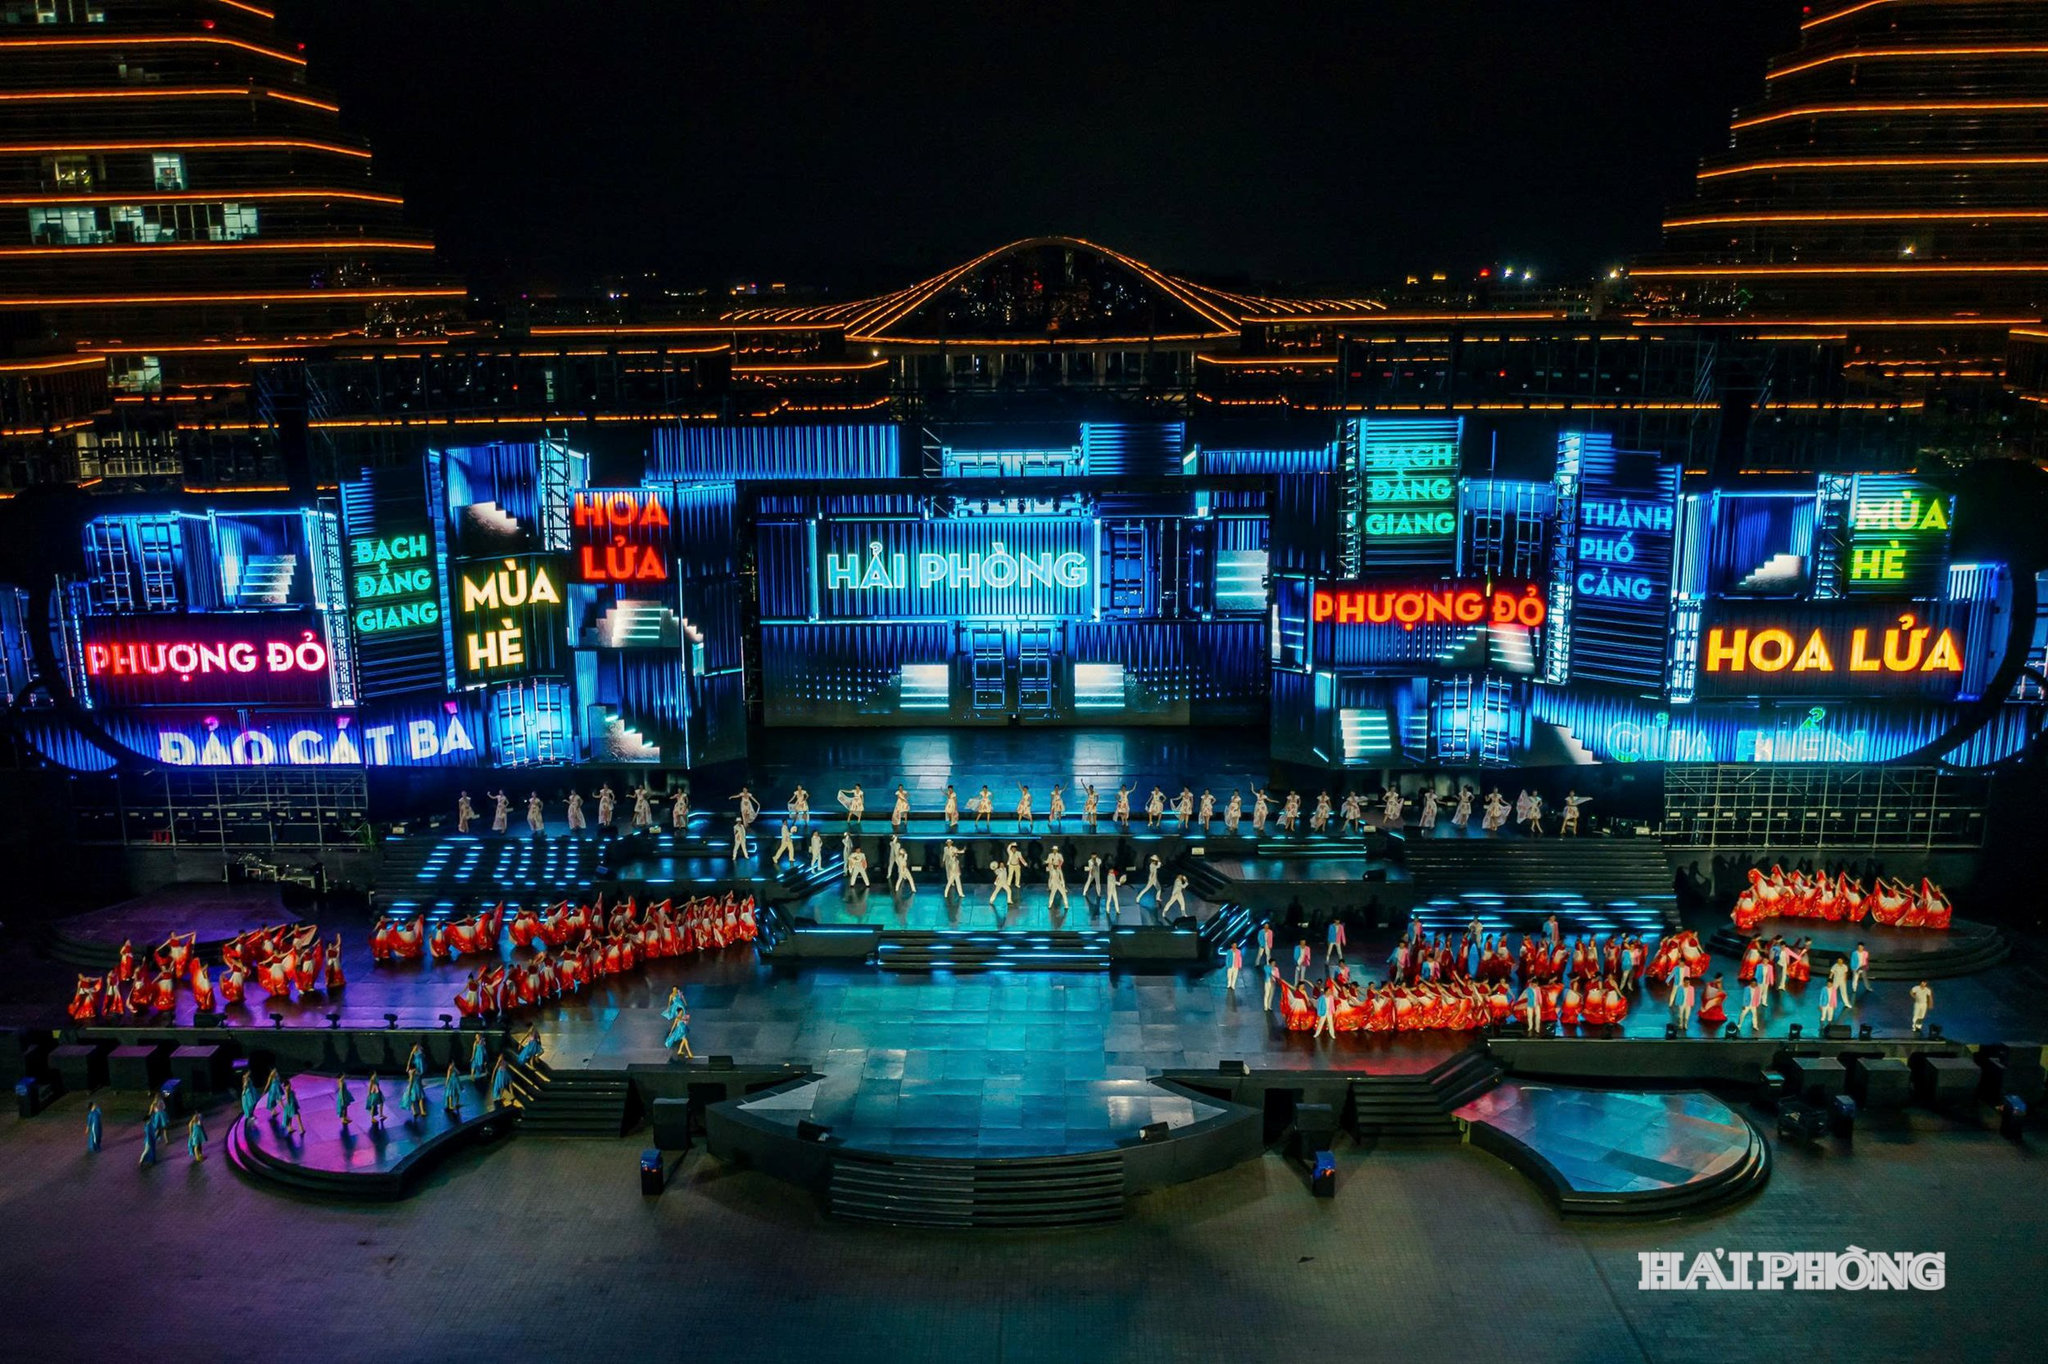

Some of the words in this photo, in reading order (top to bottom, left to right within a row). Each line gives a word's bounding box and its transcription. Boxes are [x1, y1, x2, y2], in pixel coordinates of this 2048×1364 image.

[575, 491, 669, 526] HOA
[1366, 512, 1456, 535] GIANG
[1581, 499, 1674, 530] THÀNH
[1856, 491, 1947, 530] MÙA
[356, 535, 428, 568] BẠCH
[582, 535, 667, 580] LỬA
[827, 541, 905, 589] HẢI
[919, 542, 1088, 589] PHÒNG
[1579, 531, 1635, 563] PHỐ
[1851, 540, 1906, 579] HÈ
[463, 558, 560, 612] MÙA
[1577, 567, 1652, 600] CẢNG
[356, 602, 439, 632] GIANG
[1314, 592, 1484, 632] PHƯỢNG
[1492, 585, 1545, 626] ĐỎ
[86, 642, 257, 682] PHƯỢNG
[267, 630, 326, 672] ĐỎ
[467, 618, 524, 670] HÈ
[1706, 628, 1834, 672] HOA
[1849, 614, 1963, 672] LỬA
[159, 716, 275, 765] ĐẢO
[288, 717, 394, 765] CÁT
[409, 701, 474, 760] BÀ
